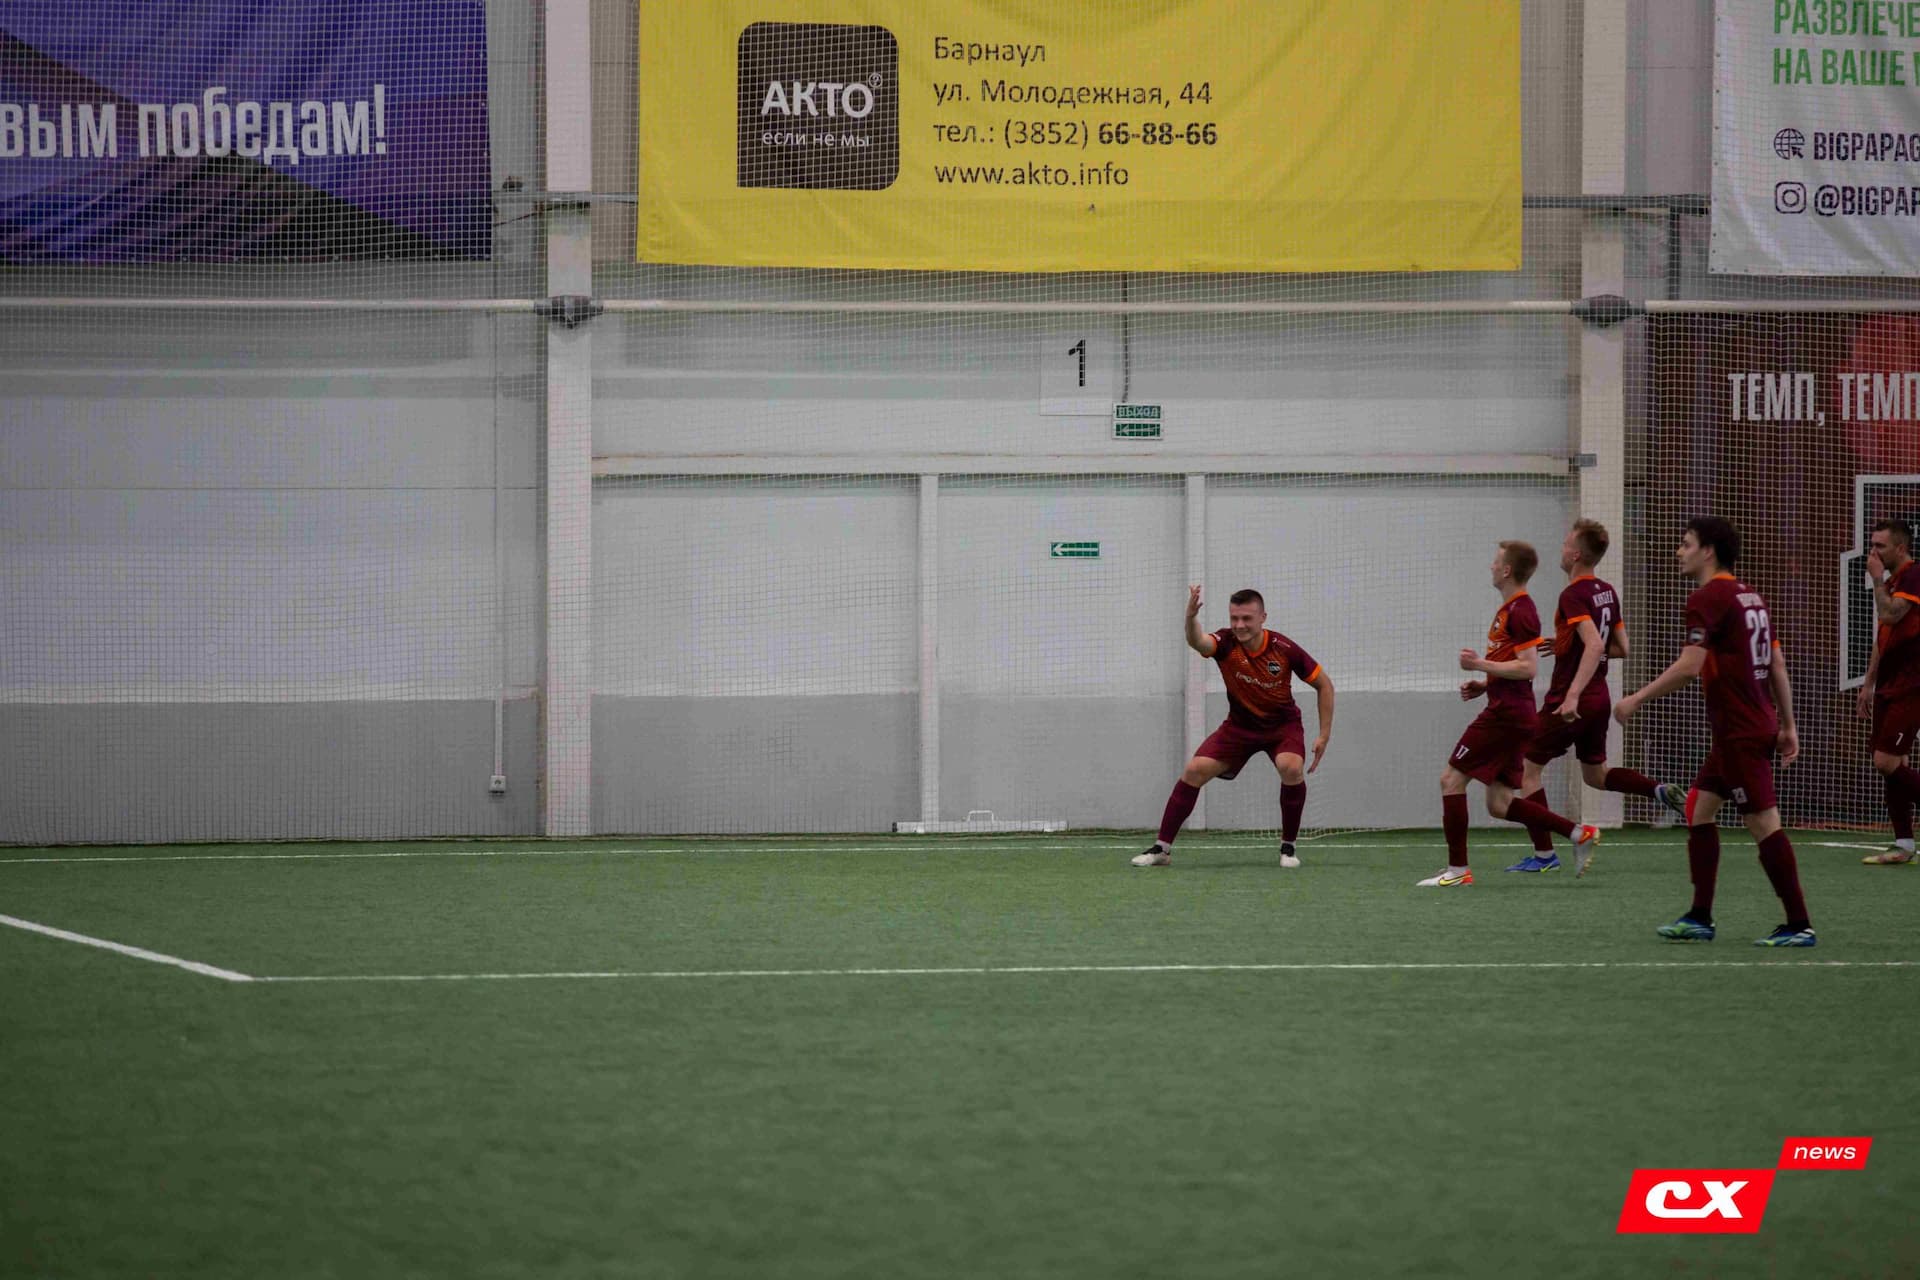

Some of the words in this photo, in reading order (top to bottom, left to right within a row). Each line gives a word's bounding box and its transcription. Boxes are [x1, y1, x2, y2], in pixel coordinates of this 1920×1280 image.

[933, 36, 1046, 66] Барнаул
[1773, 48, 1813, 85] НА
[1821, 49, 1906, 86] ВАШЕ
[760, 80, 874, 118] АКТО
[933, 82, 971, 107] ул.
[980, 79, 1171, 108] Молодежная,
[1179, 81, 1212, 105] 44
[0, 103, 118, 158] вым
[138, 84, 387, 165] победам!
[762, 131, 807, 146] если
[813, 132, 835, 147] не
[840, 133, 871, 148] мы
[933, 123, 995, 144] тел.:
[1004, 119, 1090, 150] (3852)
[1098, 122, 1219, 146] 66-88-66
[1813, 132, 1920, 162] BIGPAPAG
[934, 160, 1130, 187] www.akto.info
[1068, 339, 1086, 387] 1
[1117, 406, 1159, 418] ВЫХОД
[1728, 373, 1825, 426] ТЕМП,
[1838, 373, 1920, 421] ТЕМП
[1744, 608, 1771, 666] 23
[1455, 744, 1470, 760] 17
